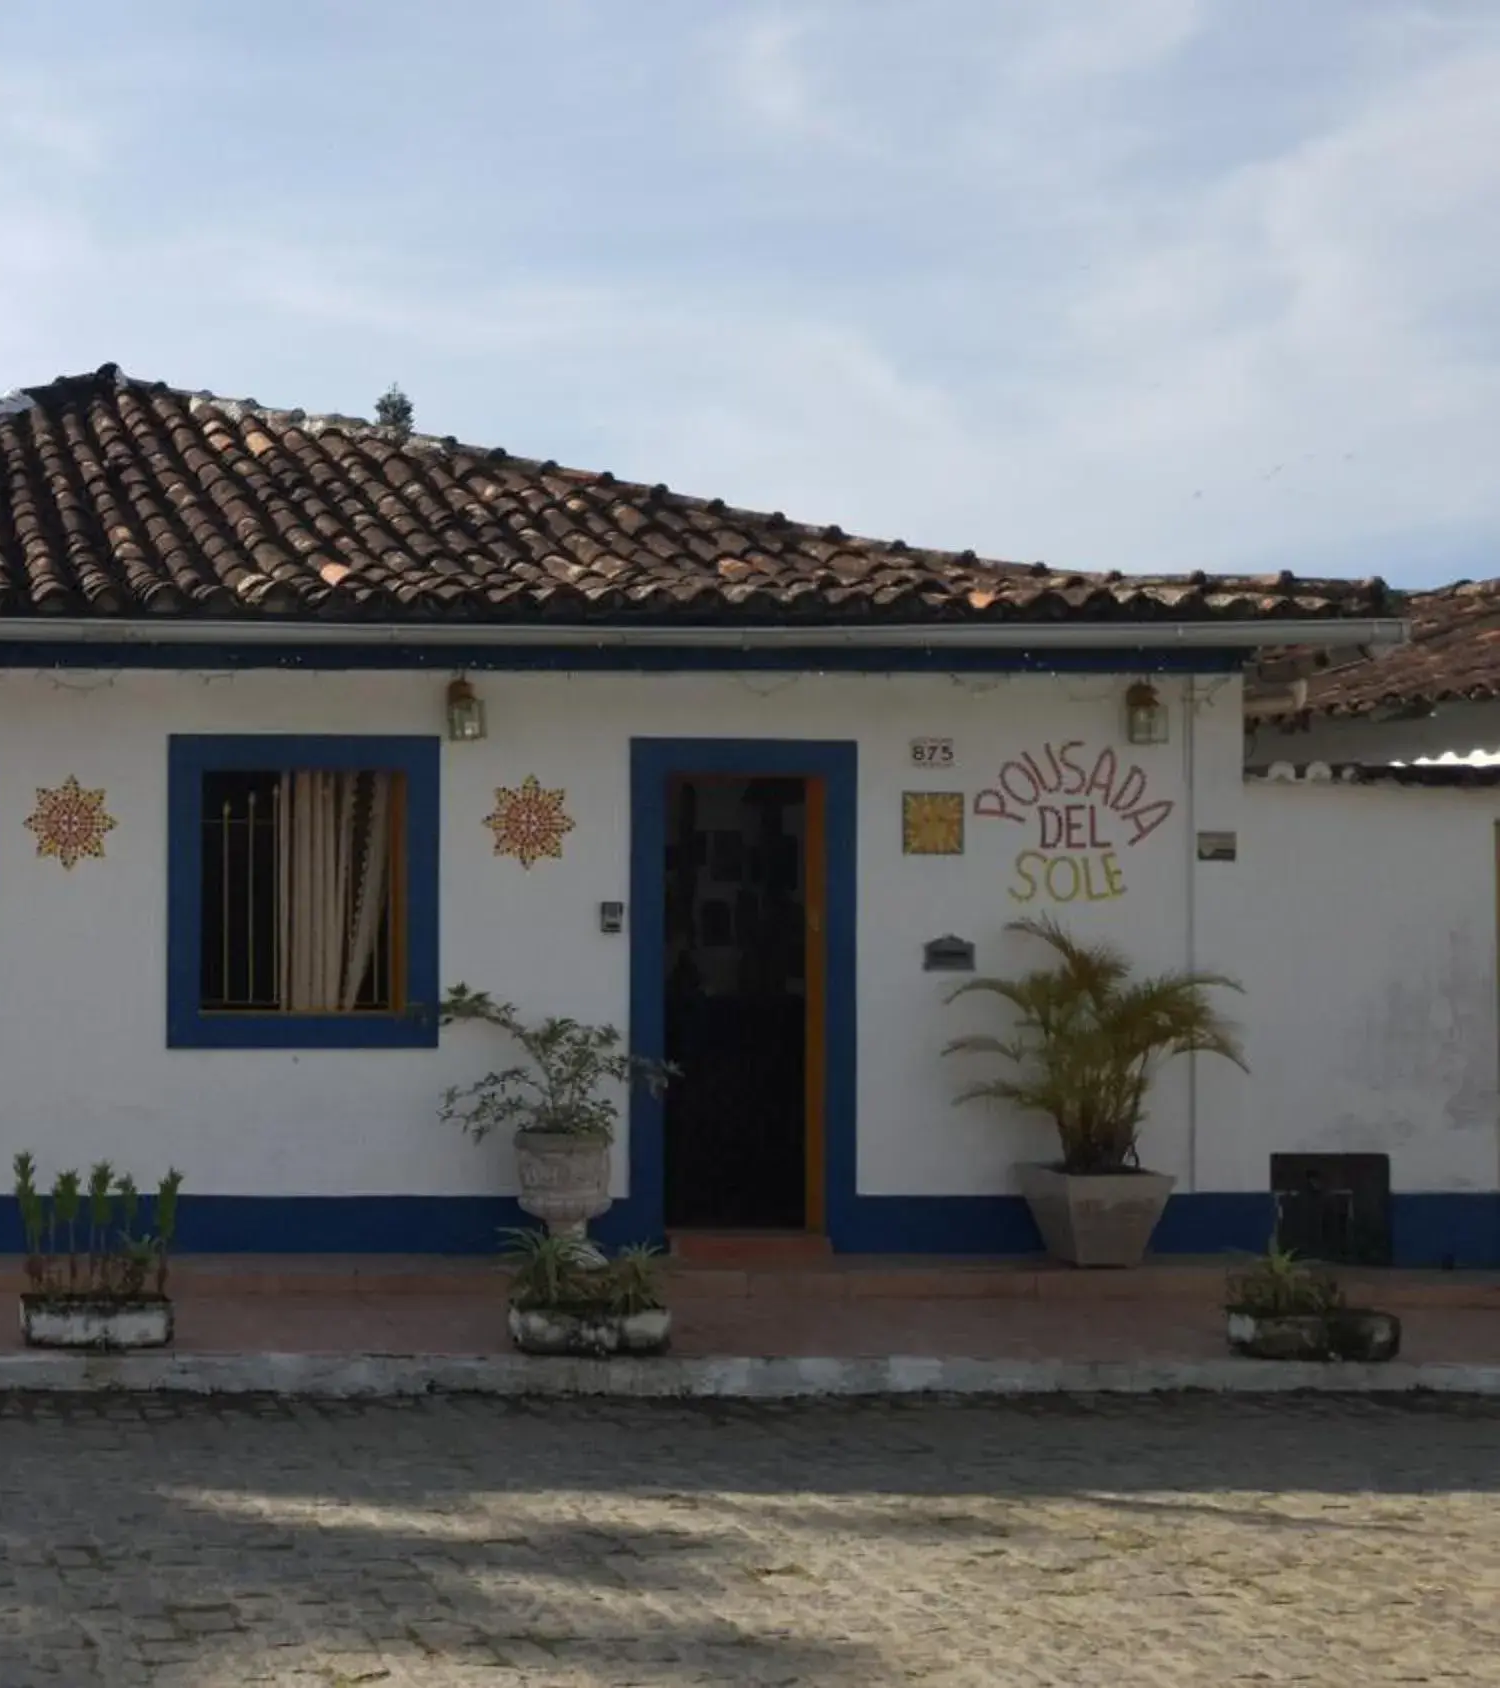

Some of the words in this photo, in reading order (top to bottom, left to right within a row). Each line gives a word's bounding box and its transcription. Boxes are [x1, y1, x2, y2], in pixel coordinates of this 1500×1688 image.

[912, 745, 954, 761] 875
[974, 740, 1175, 846] POUSADA
[1037, 804, 1112, 849] DEL
[1008, 851, 1128, 902] SOLE
